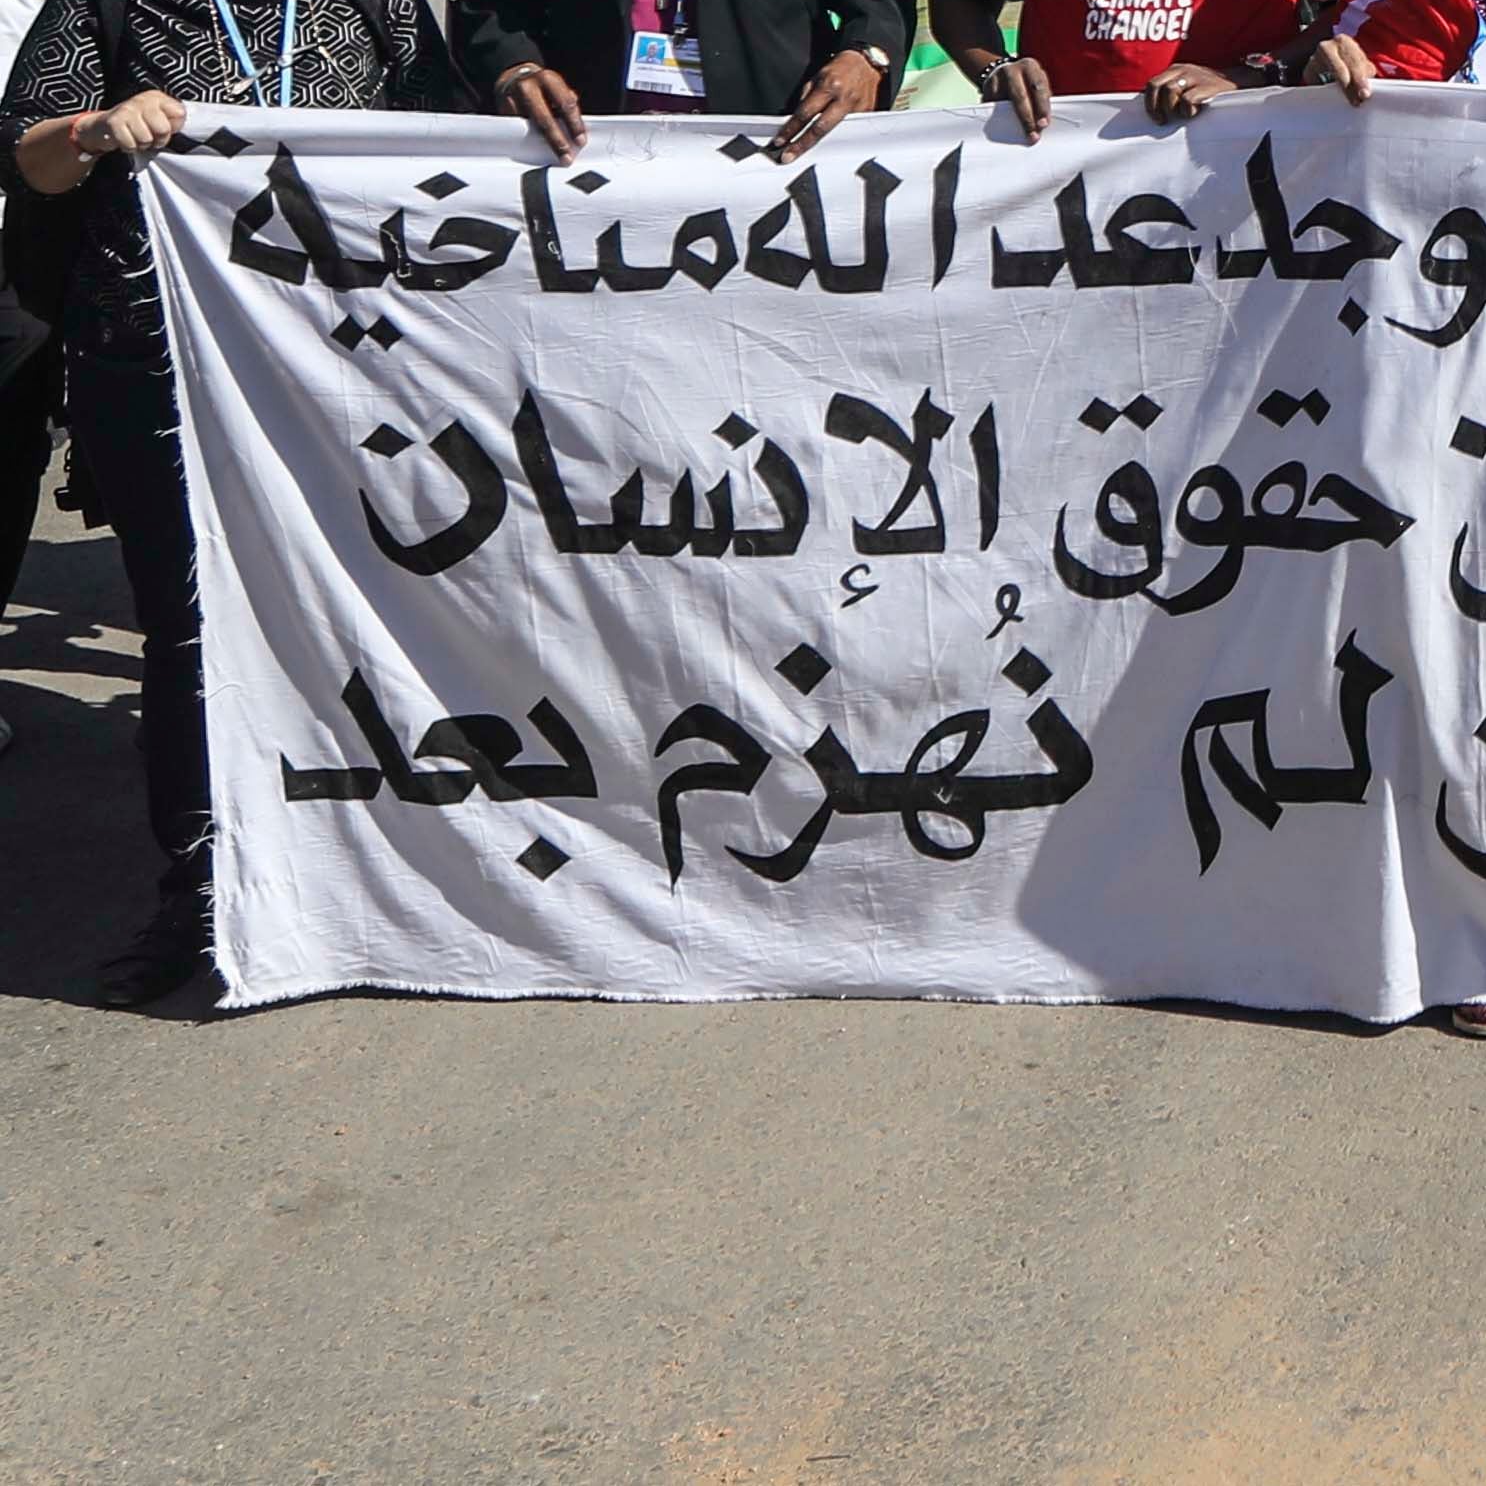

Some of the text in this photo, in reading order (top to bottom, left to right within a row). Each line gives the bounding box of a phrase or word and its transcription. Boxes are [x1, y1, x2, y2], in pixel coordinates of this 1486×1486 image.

[1084, 7, 1194, 42] CHANGE!
[164, 124, 740, 352] مناخية
[1052, 387, 1418, 618] حقوق
[280, 667, 598, 882] بعد
[1180, 628, 1395, 876] لم
